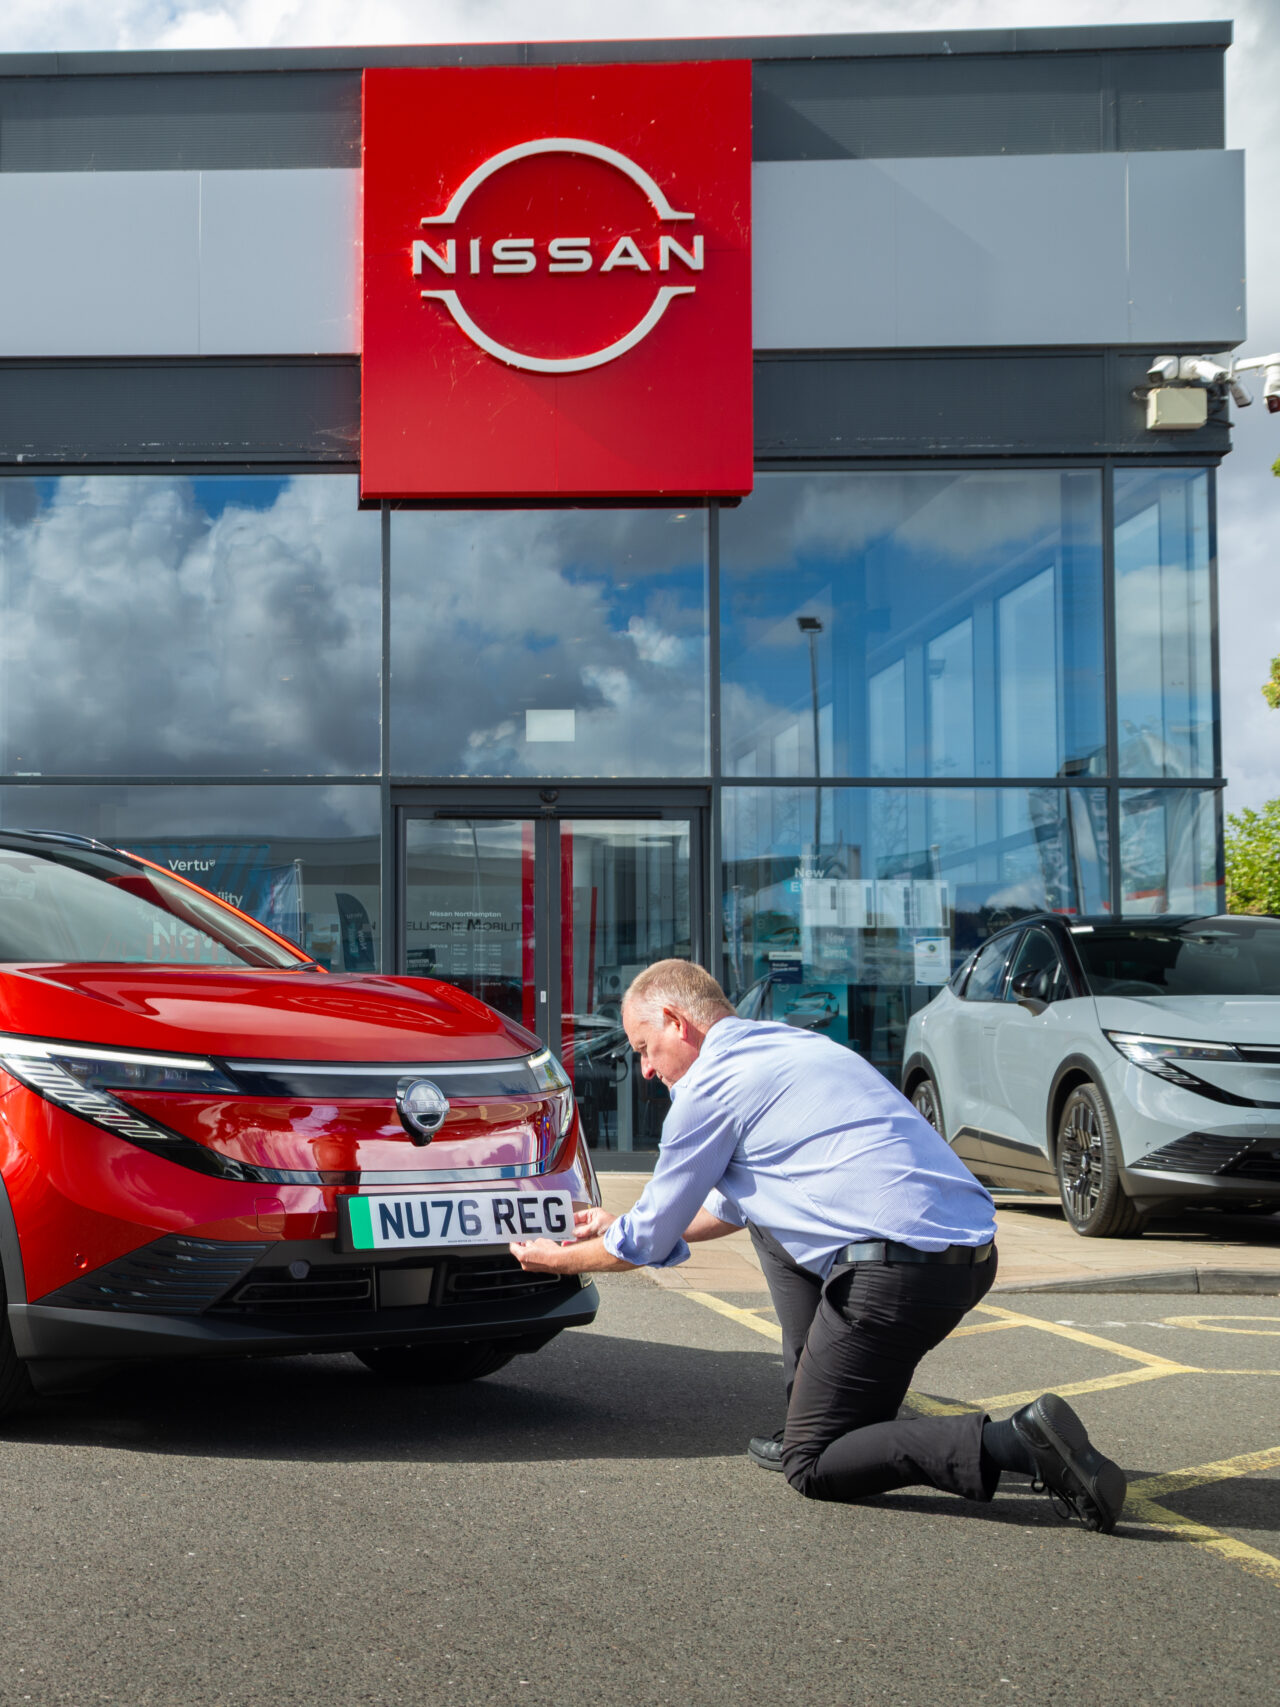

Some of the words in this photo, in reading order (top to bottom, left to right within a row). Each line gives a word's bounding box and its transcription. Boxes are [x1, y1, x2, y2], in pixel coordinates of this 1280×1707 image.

[412, 235, 704, 277] NISSAN
[169, 860, 209, 871] Vertu
[795, 867, 825, 878] New
[454, 911, 501, 919] Northampton
[378, 1199, 482, 1240] NU76
[491, 1196, 567, 1236] REG
